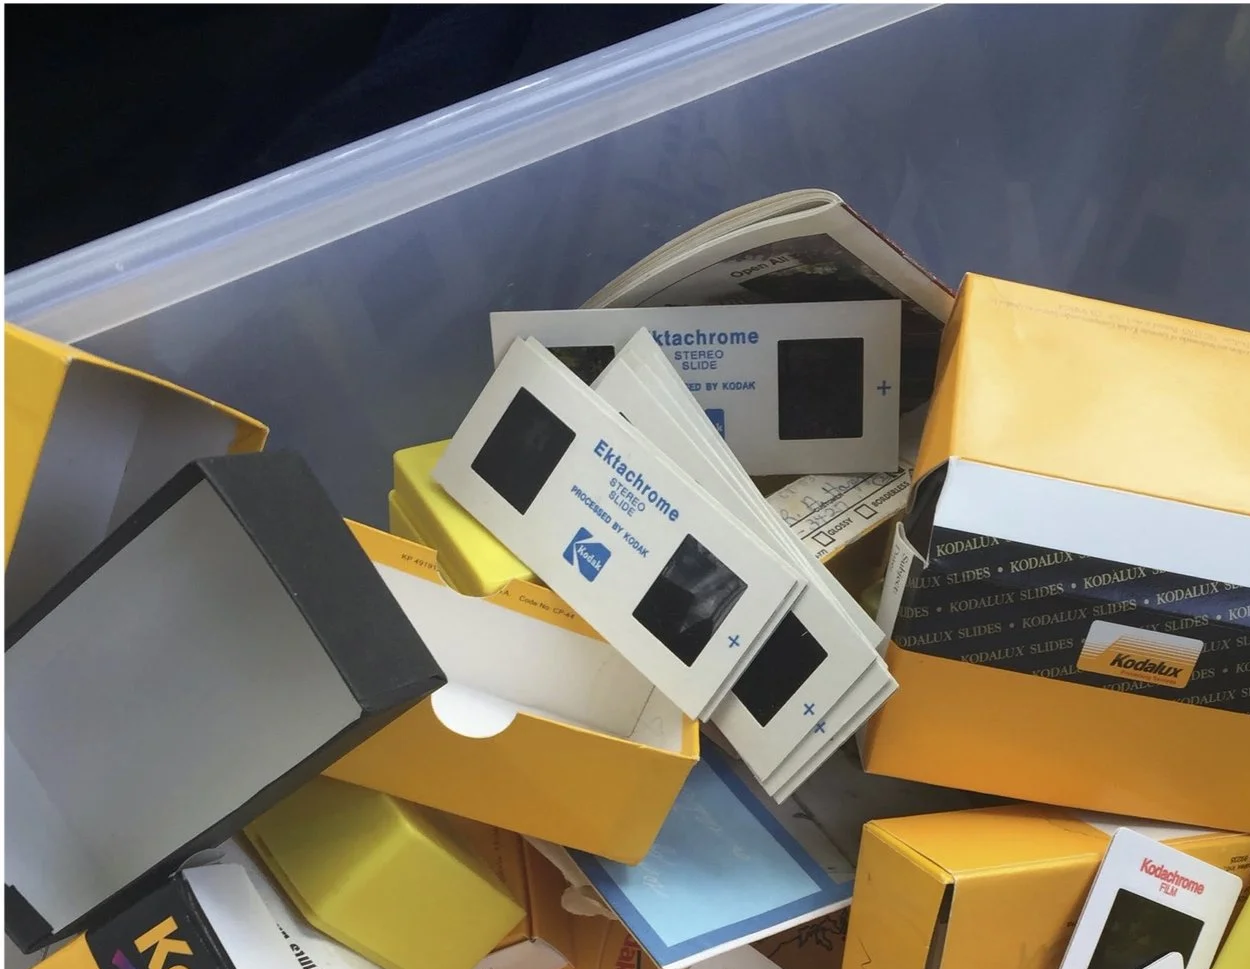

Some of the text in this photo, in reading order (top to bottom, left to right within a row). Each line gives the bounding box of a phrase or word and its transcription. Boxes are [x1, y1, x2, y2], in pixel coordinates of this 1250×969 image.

[730, 258, 768, 278] Open
[651, 329, 759, 346] ktachrome
[674, 350, 724, 360] STEREO
[682, 361, 717, 370] SLIDE
[706, 382, 717, 391] BY
[722, 381, 756, 390] KODAK
[593, 439, 679, 522] Ektachrome
[608, 490, 635, 517] SLIDE
[609, 477, 646, 512] STEREO
[570, 485, 649, 558] PROCESSED BY KODAK
[828, 481, 910, 536] GLOSSY BORDERLESS
[577, 545, 602, 571] Kodak
[936, 537, 1000, 557] KODALUX
[946, 551, 1073, 585] SLIDES KODALUX
[519, 594, 538, 607] Code
[950, 566, 1147, 613] KODALUX SLIDES KODALUX
[958, 622, 1002, 639] SLIDES
[1022, 607, 1087, 629] KODALUX
[1092, 599, 1137, 617] SLIDES
[1156, 582, 1219, 605] KODALUX
[1164, 614, 1209, 631] SLIDES
[1030, 638, 1074, 654] SLIDES
[1110, 652, 1184, 679] Kodalux
[1140, 857, 1205, 895] Kodachrome
[1159, 882, 1178, 897] FILM
